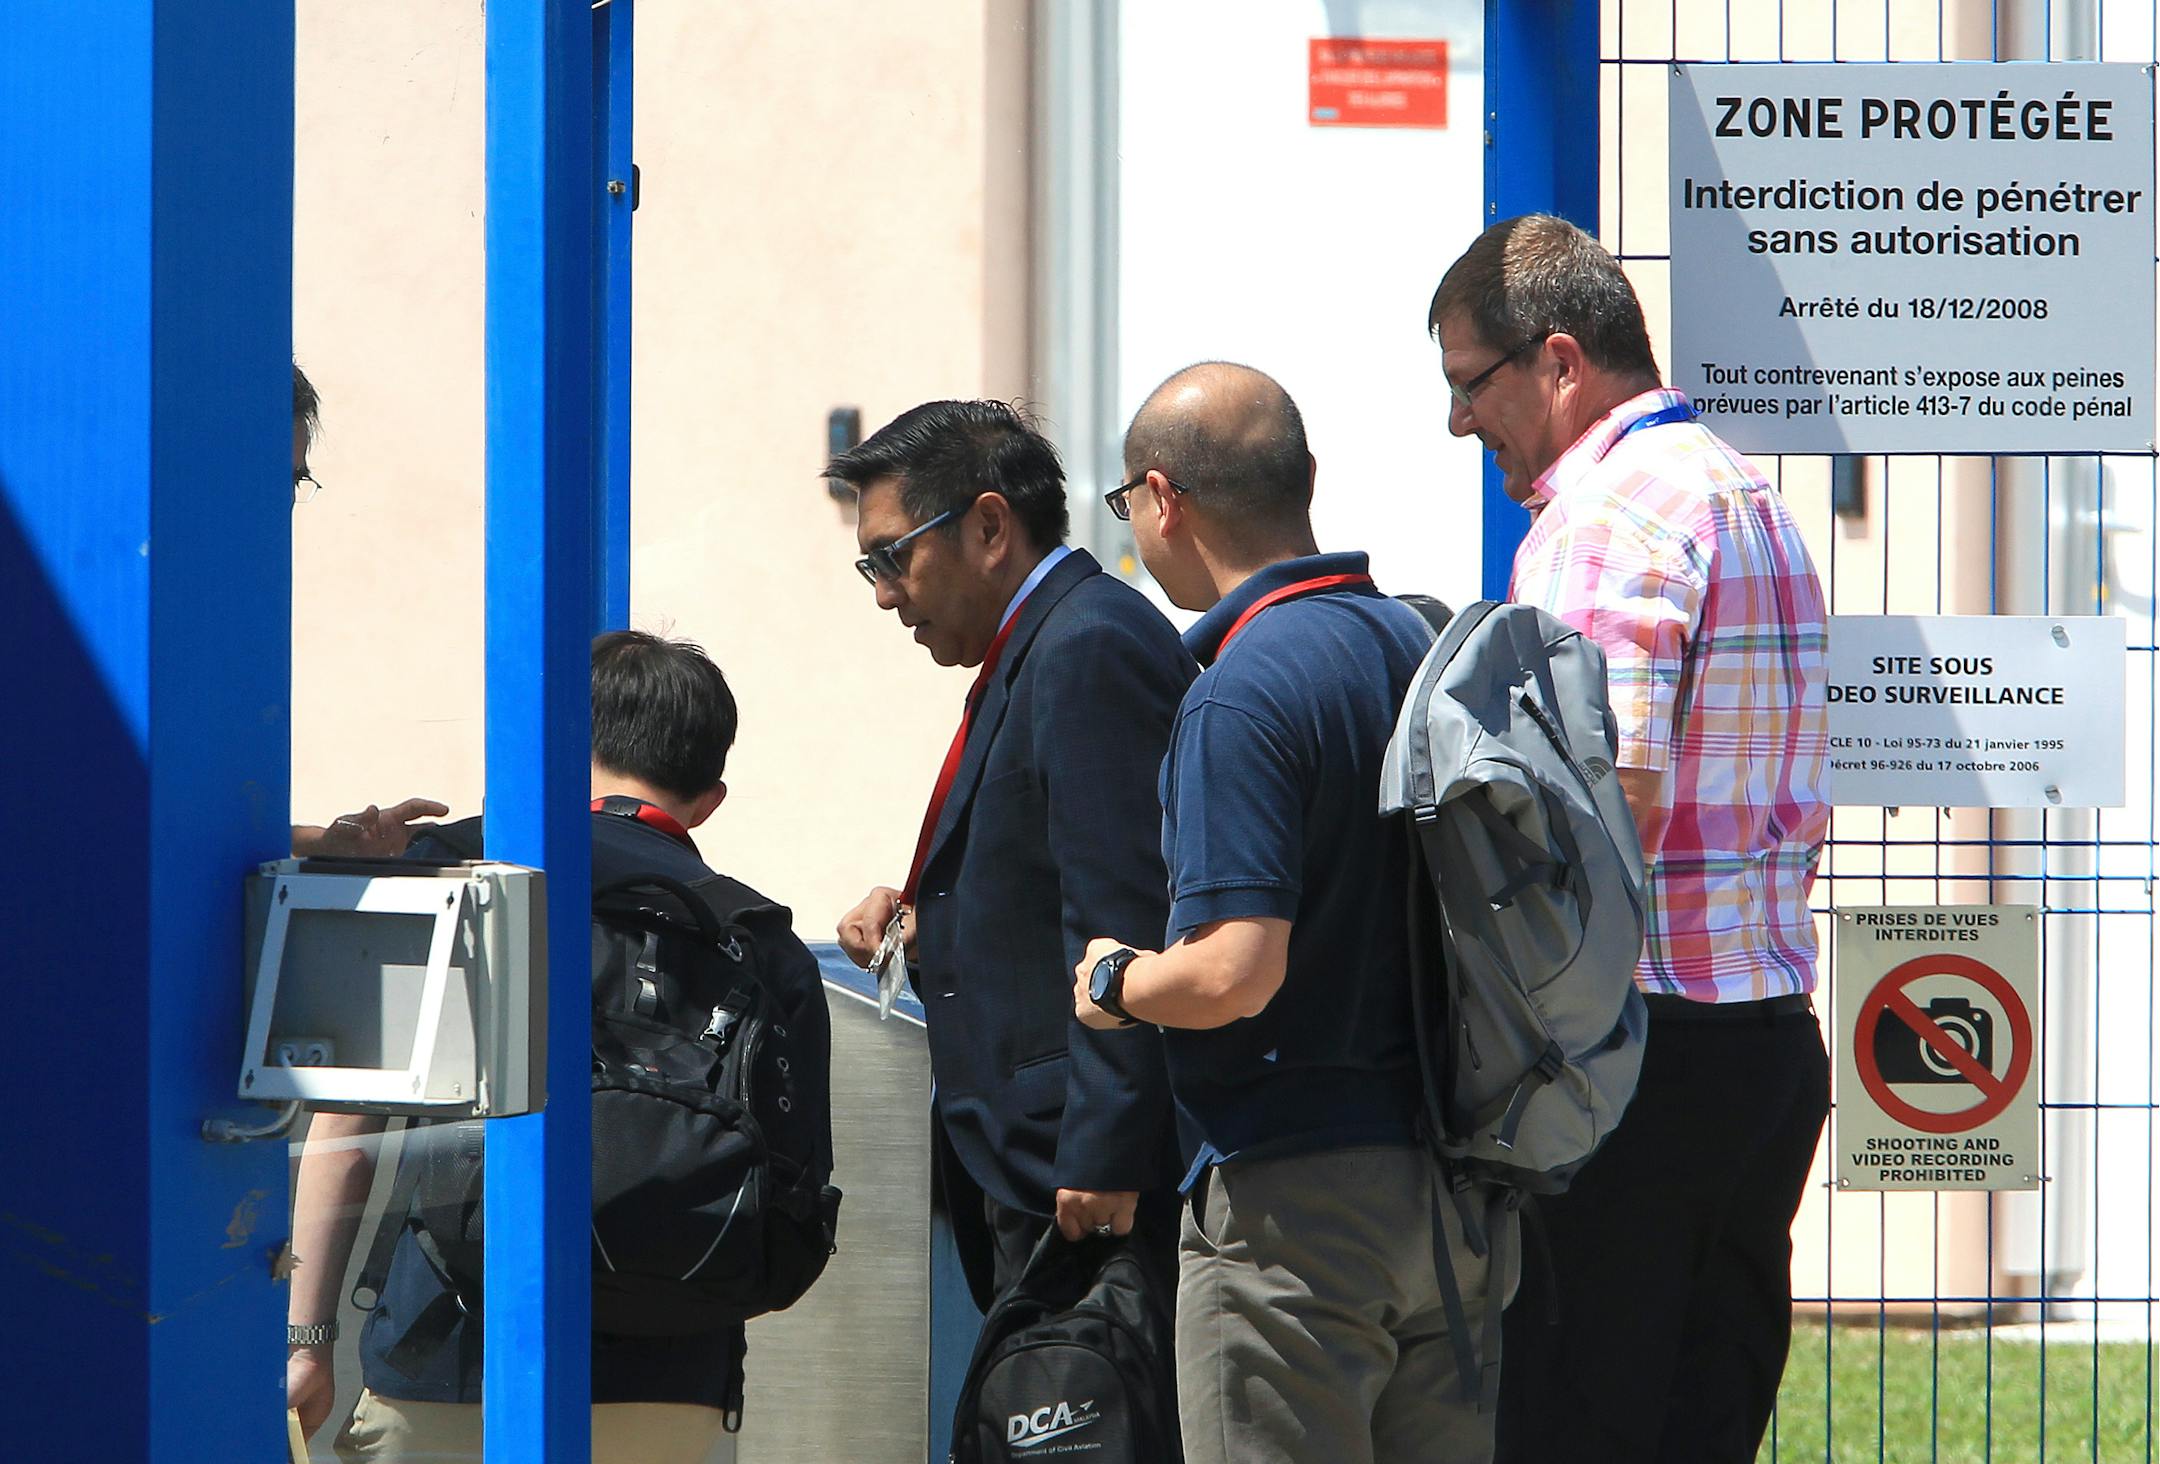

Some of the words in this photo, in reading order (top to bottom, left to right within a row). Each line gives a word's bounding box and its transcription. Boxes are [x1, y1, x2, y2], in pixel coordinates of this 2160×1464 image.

[1716, 98, 1842, 138] ZONE
[1862, 91, 2112, 140] PROTÉGÉE
[1685, 179, 1903, 210] Interdiction
[1917, 181, 1963, 211] de
[1977, 181, 2141, 218] pénétrer
[1748, 231, 1838, 253] sans
[1851, 225, 2079, 256] autorisation
[1779, 297, 1859, 317] Arrêté
[1868, 298, 1898, 318] du
[1908, 298, 2047, 319] 18/12/2008
[1702, 363, 1747, 384] Tout
[1755, 366, 1897, 385] contrevenant
[1905, 366, 2000, 391] s'expose
[2007, 372, 2045, 387] aux
[2053, 368, 2124, 391] peines
[1692, 393, 1779, 416] prévues
[1787, 399, 1822, 419] par
[1829, 394, 1909, 415] l'article
[1916, 396, 1971, 415] 413-7
[1979, 396, 2004, 415] du
[2012, 396, 2066, 416] code
[2073, 397, 2131, 420] pénal
[1873, 657, 1921, 674] SITE
[1930, 658, 1992, 675] SOUS
[1827, 686, 1876, 703] DEO
[1885, 686, 2063, 704] SURVEILLANCE
[1830, 737, 1851, 747] CLE
[1858, 738, 1871, 748] 10
[1884, 738, 1902, 748] Loi
[1907, 738, 1940, 748] 95-73
[1945, 738, 1961, 748] du
[1966, 739, 1979, 748] 21
[1985, 739, 2029, 751] janvier
[2035, 740, 2063, 749] 1995
[1871, 760, 1912, 770] 96-926
[1917, 760, 1932, 770] du
[1938, 761, 1951, 770] 17
[1956, 761, 2005, 771] octobre
[2010, 762, 2039, 771] 2006
[1857, 914, 1917, 925] PRISES
[1924, 914, 1946, 925] DE
[1952, 914, 1998, 926] VUES
[1876, 929, 1979, 941] INTERDITES
[1867, 1138, 1958, 1150] SHOOTING
[1964, 1139, 1999, 1150] AND
[1852, 1154, 1904, 1166] VIDEO
[1912, 1154, 2013, 1166] RECORDING
[1880, 1169, 1986, 1181] PROHIBITED
[1007, 1401, 1073, 1443] DCA
